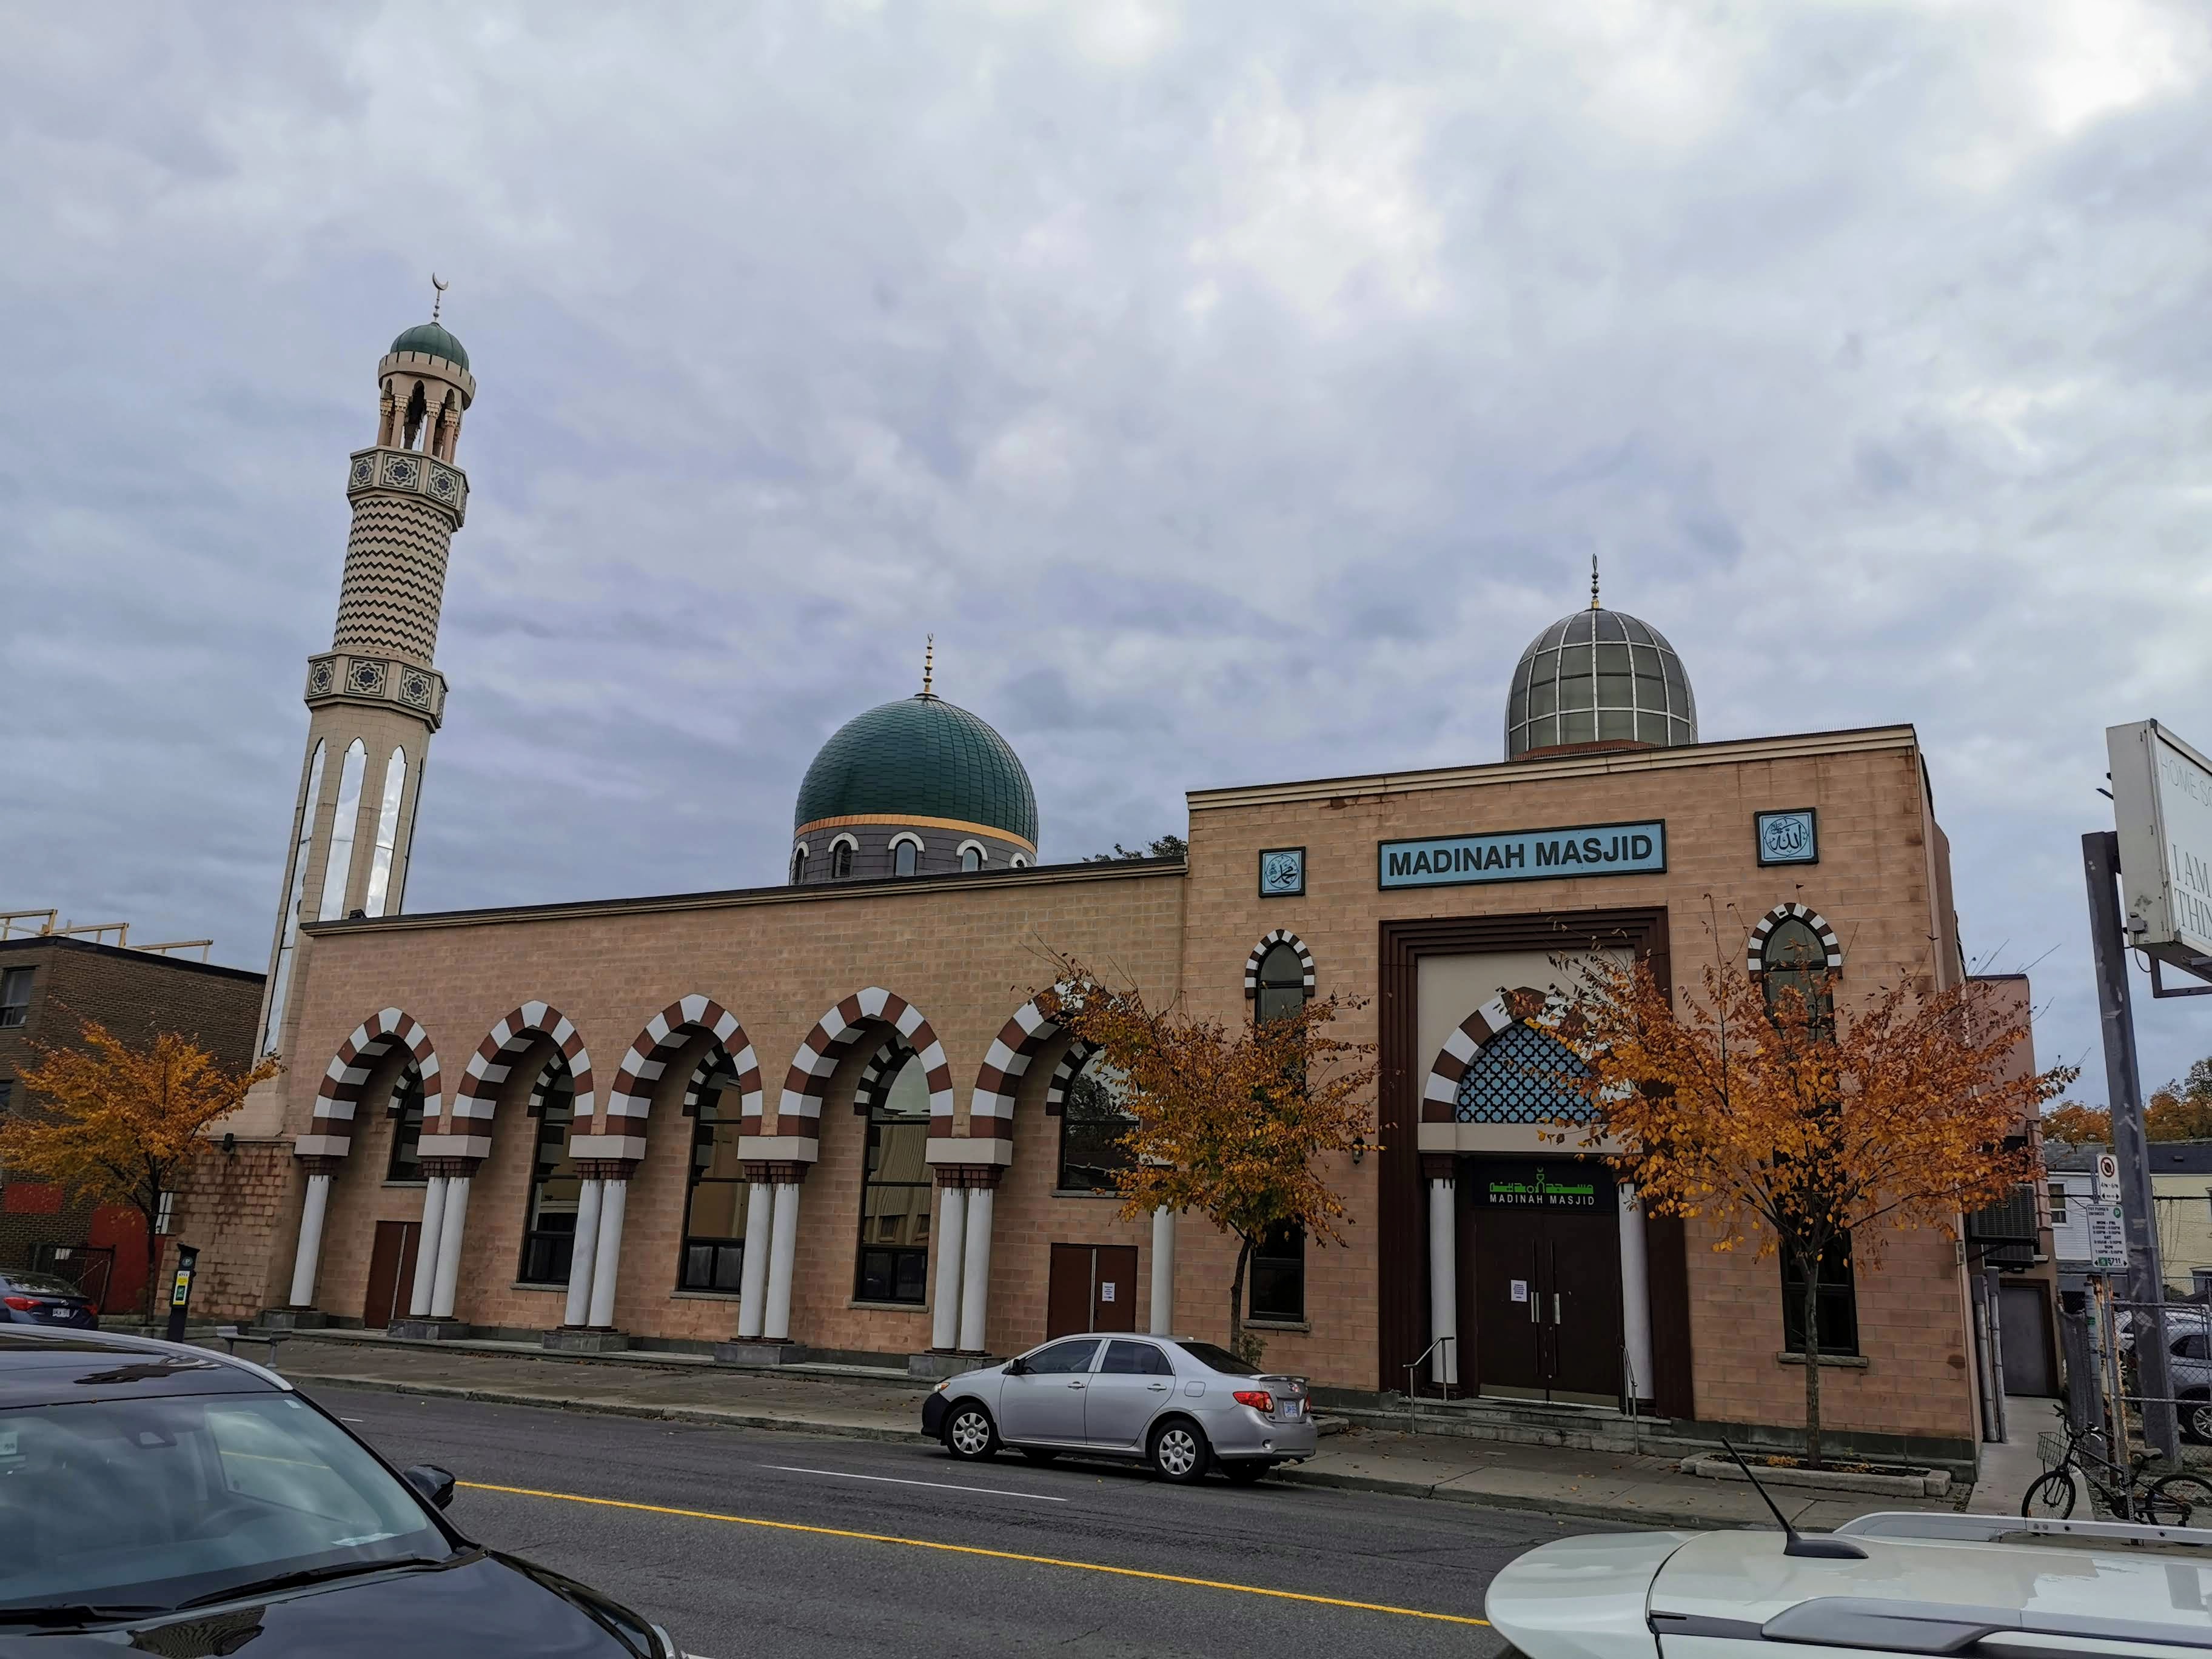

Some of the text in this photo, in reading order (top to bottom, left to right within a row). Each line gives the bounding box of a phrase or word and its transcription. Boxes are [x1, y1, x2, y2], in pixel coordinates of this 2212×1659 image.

[1389, 834, 1652, 876] MADINAH MASJID
[2172, 843, 2212, 899] I AM
[1489, 1194, 1595, 1205] MADINAH MASJID
